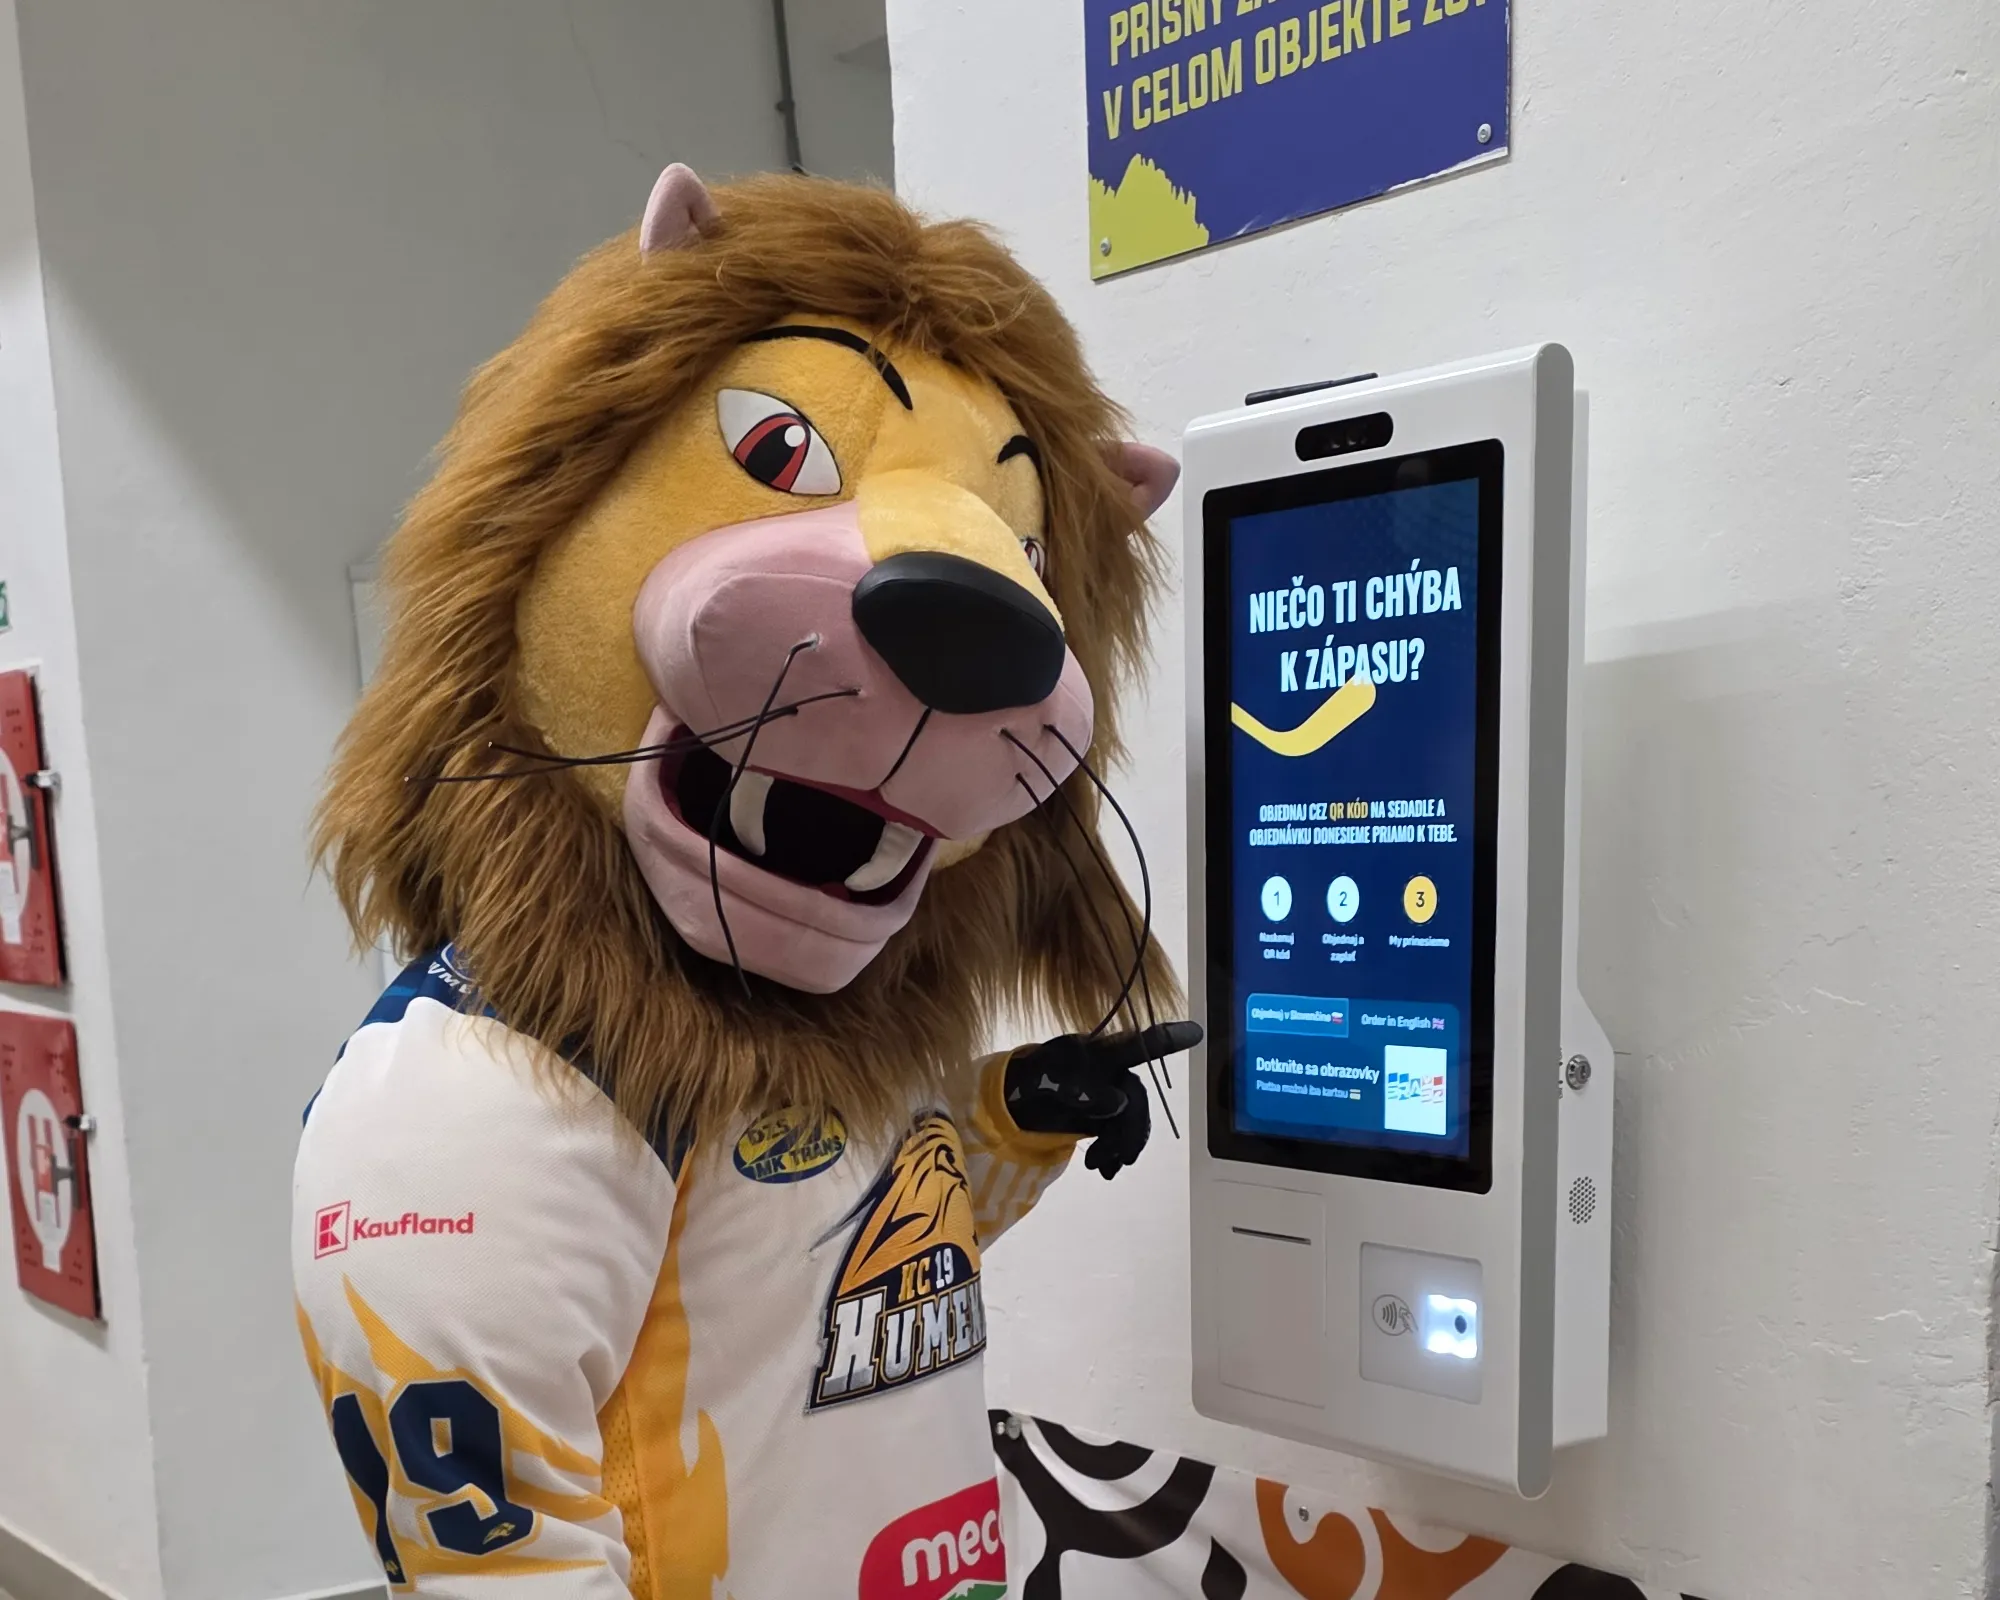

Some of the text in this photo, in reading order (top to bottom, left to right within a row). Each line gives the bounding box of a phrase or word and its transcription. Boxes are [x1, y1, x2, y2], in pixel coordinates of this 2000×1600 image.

[1103, 0, 1412, 140] V CELOM OBJEKTE
[1249, 558, 1462, 634] NIEČO TI CHÝBA
[1281, 634, 1425, 692] K ZÁPASU?
[1259, 797, 1446, 822] OBJEDNAJ CEZ QR KÓD NA SEDADLE A
[1249, 823, 1457, 846] OBJEDNÁVKU DONESIEME PRIAMO K TEBE.
[1274, 891, 1281, 906] 1
[1339, 892, 1348, 906] 2
[1415, 891, 1425, 907] 3
[1361, 1013, 1431, 1031] Order in English
[1256, 1057, 1380, 1085] Dotknite sa obrazovky
[353, 1212, 475, 1241] Kaufland
[935, 1247, 955, 1289] 19
[331, 1380, 535, 1585] 19
[901, 1509, 1005, 1587] mec
